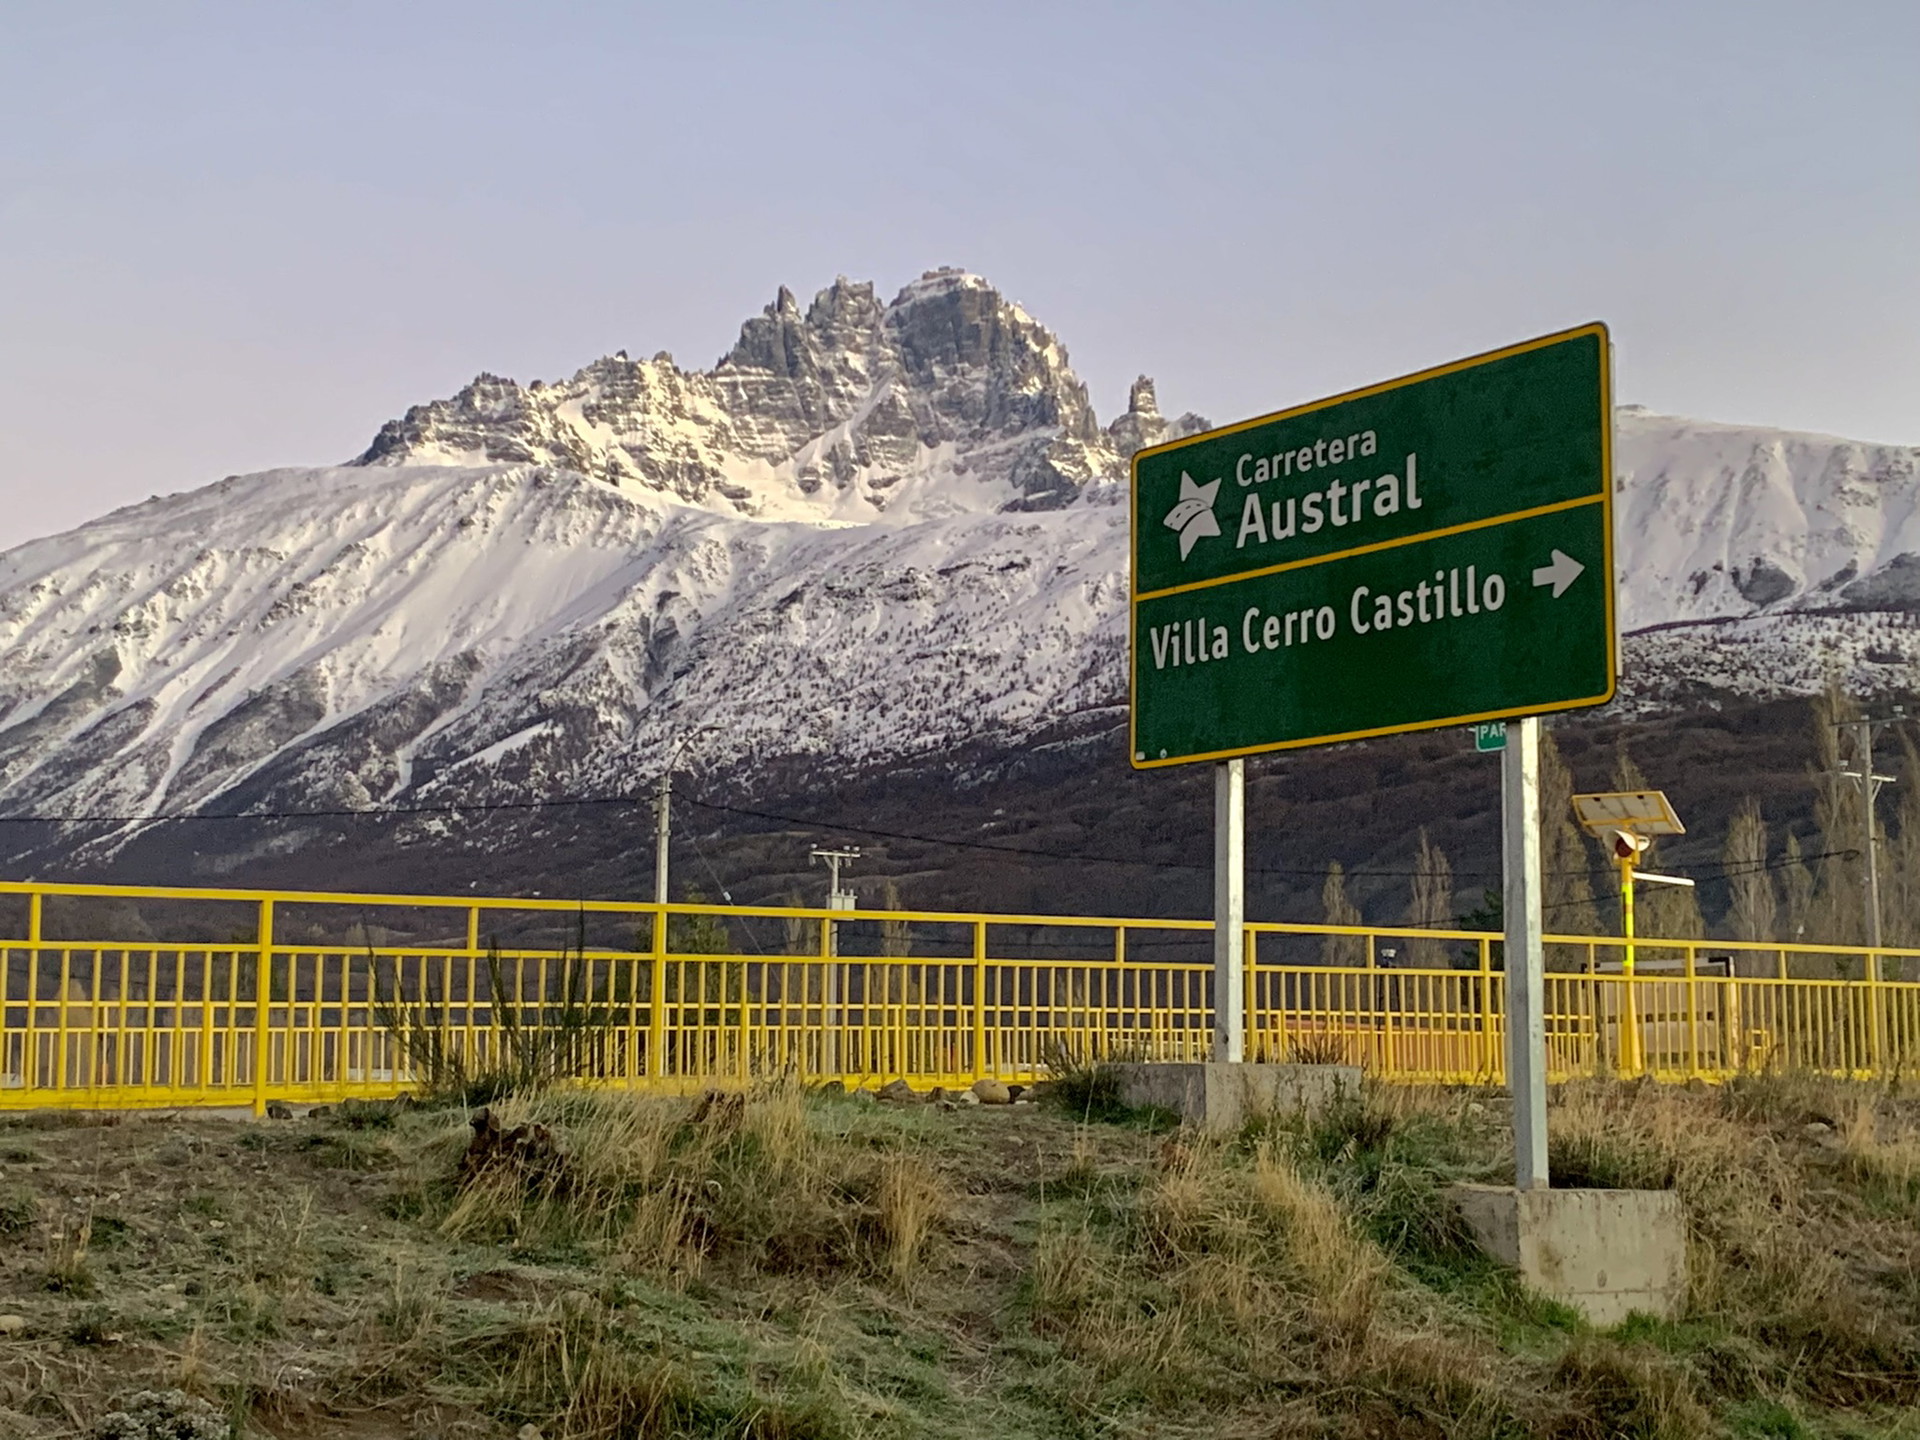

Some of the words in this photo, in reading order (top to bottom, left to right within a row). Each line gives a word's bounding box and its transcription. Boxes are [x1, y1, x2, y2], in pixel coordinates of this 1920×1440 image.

[1236, 430, 1376, 487] Carretera
[1236, 452, 1422, 549] Austral
[1151, 617, 1228, 669] Villa
[1242, 606, 1335, 654] Cerro
[1351, 565, 1505, 635] Castillo
